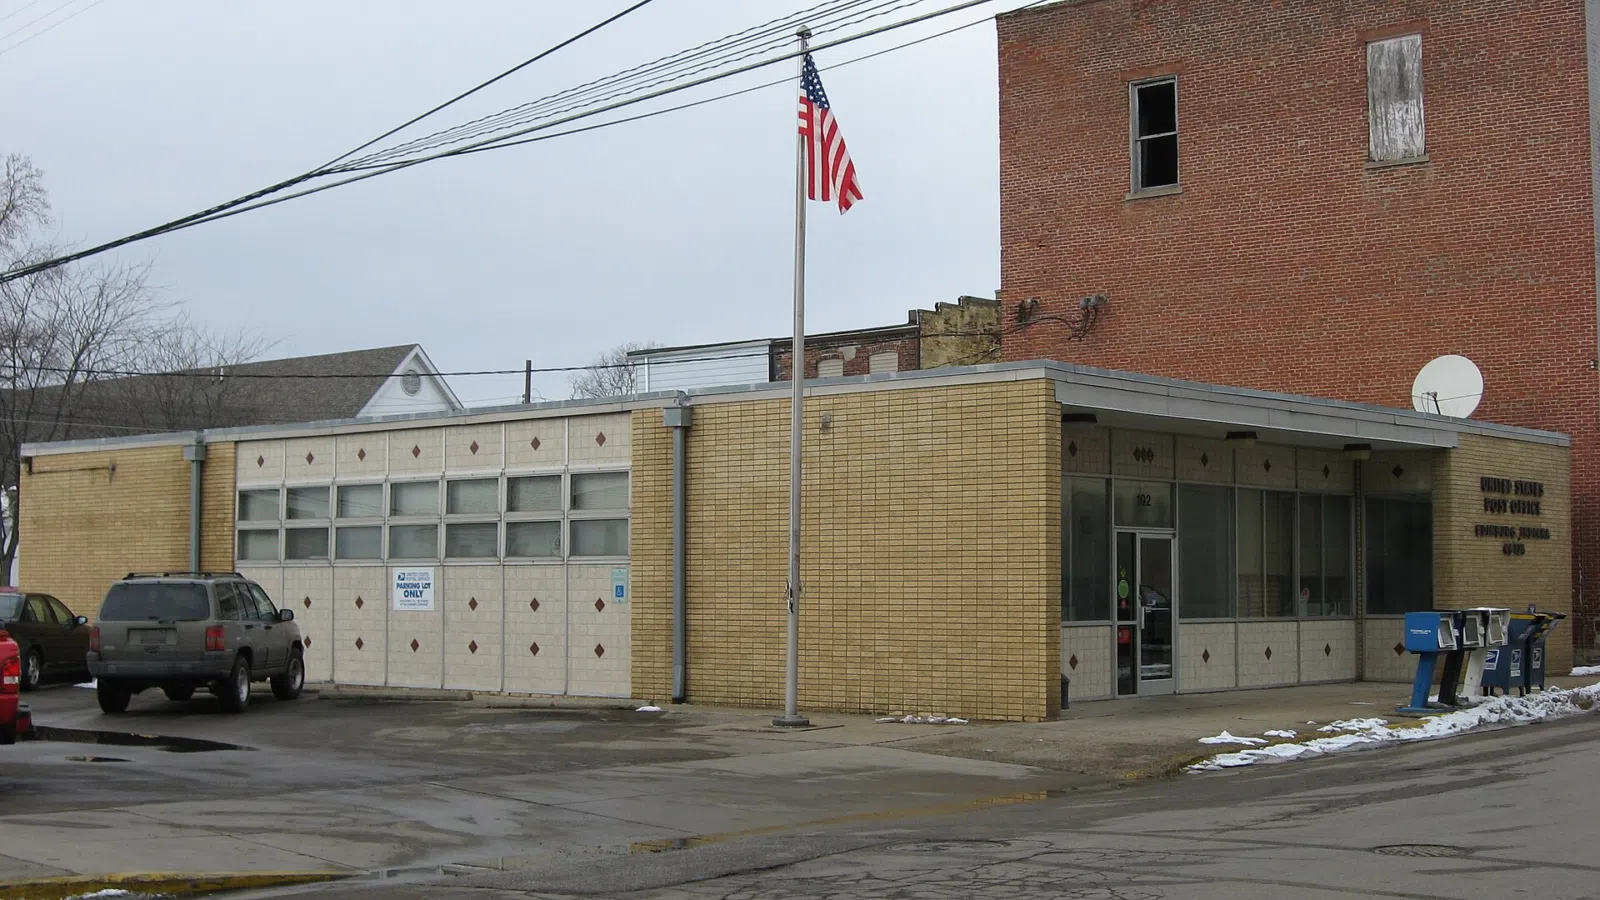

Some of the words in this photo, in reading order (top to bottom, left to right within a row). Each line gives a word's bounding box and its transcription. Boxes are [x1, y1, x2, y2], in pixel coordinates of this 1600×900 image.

[1480, 476, 1512, 493] UNITED
[1514, 480, 1544, 497] STATES
[1136, 493, 1152, 506] 102
[1484, 497, 1507, 514] POST
[1510, 500, 1541, 516] OFFICE
[403, 590, 424, 598] ONLY
